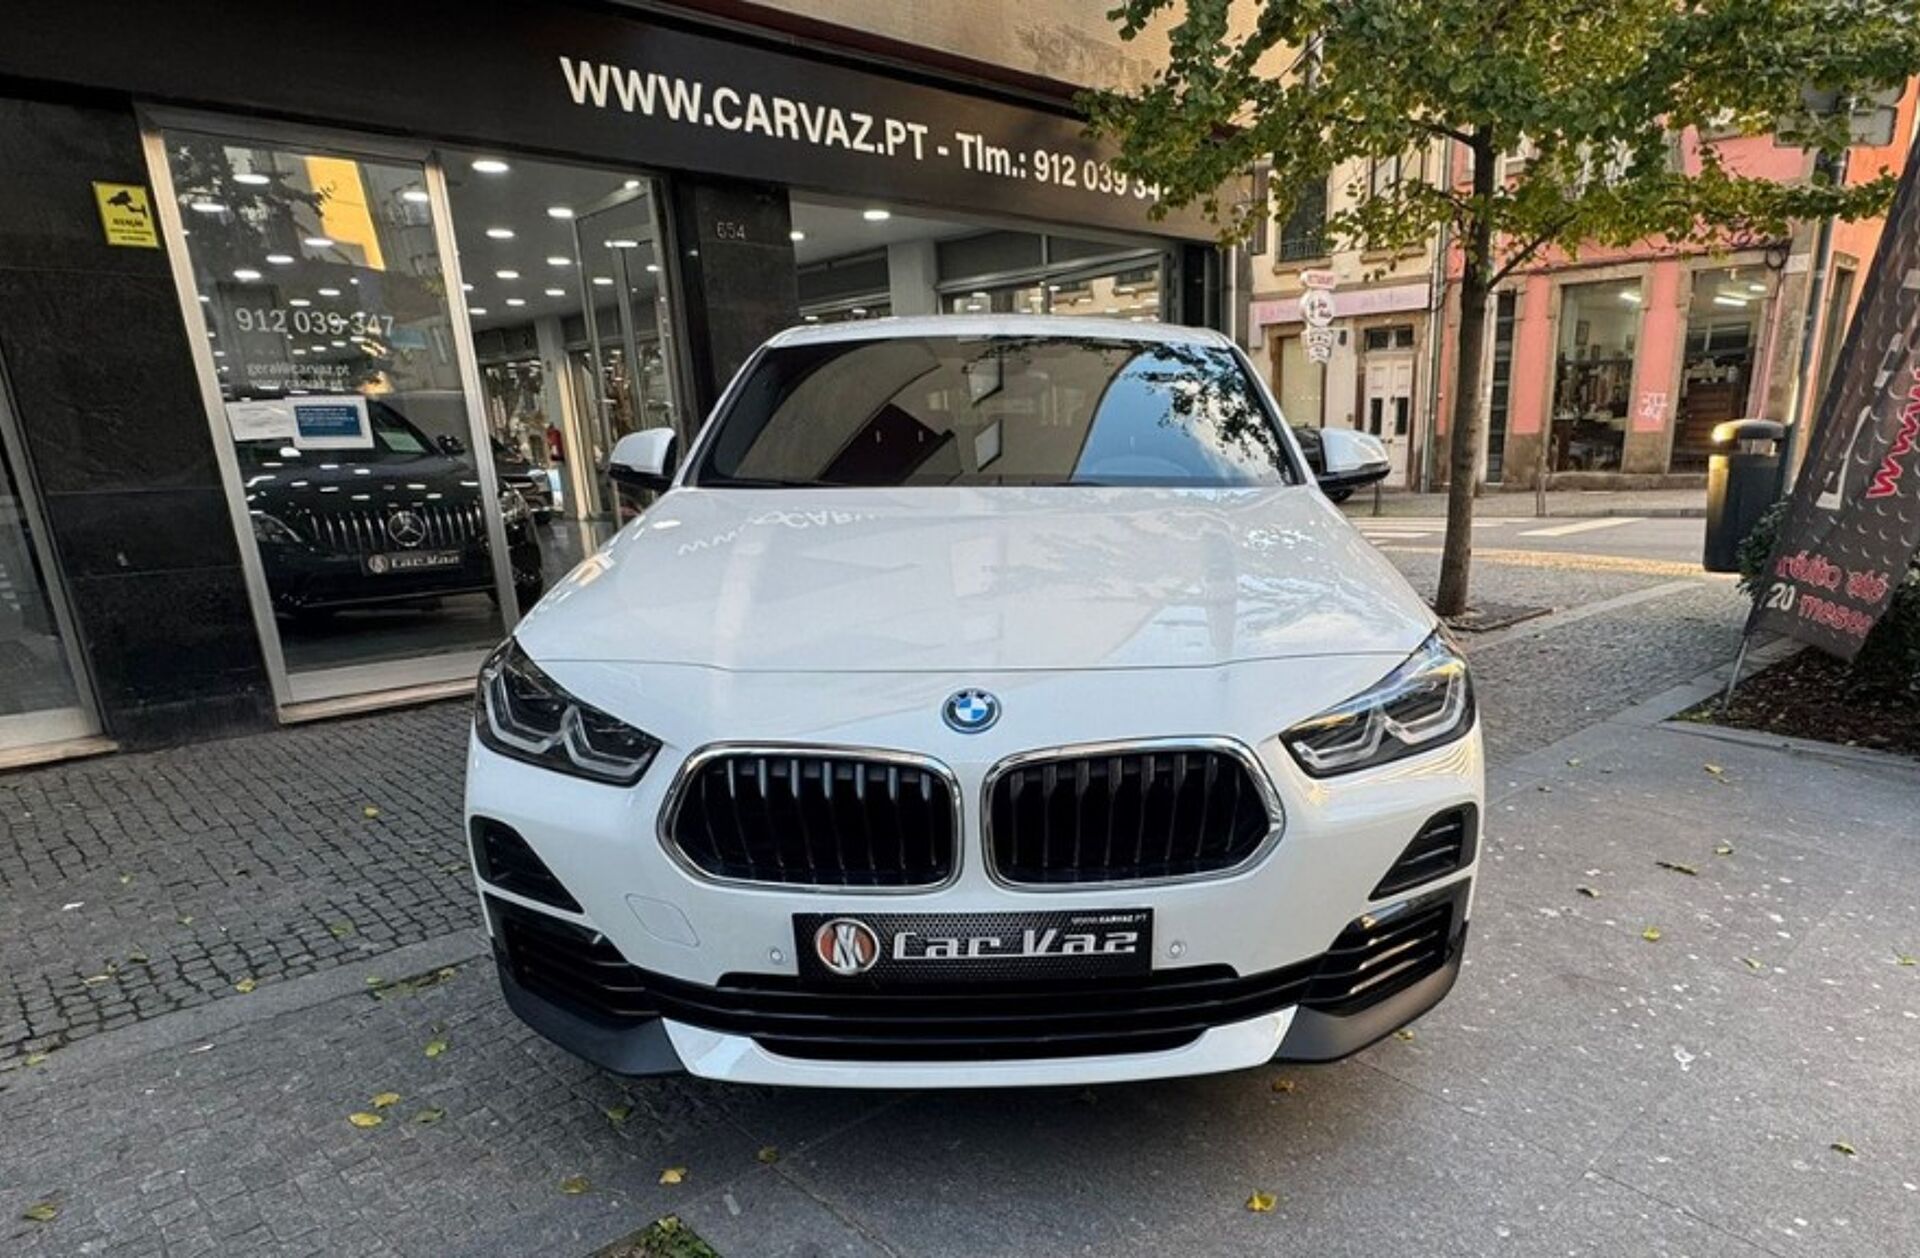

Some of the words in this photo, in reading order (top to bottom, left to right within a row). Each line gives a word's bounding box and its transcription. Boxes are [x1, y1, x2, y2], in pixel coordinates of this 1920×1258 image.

[560, 56, 928, 160] WWW.CARVAZ.PT
[955, 132, 1027, 179] Tlm.:
[1034, 149, 1077, 187] 912
[1083, 160, 1128, 196] 039
[1132, 177, 1171, 202] 34
[717, 221, 745, 240] 654
[235, 307, 288, 333] 912
[293, 310, 345, 335] 039
[350, 312, 395, 338] 347
[893, 931, 1001, 960] Car
